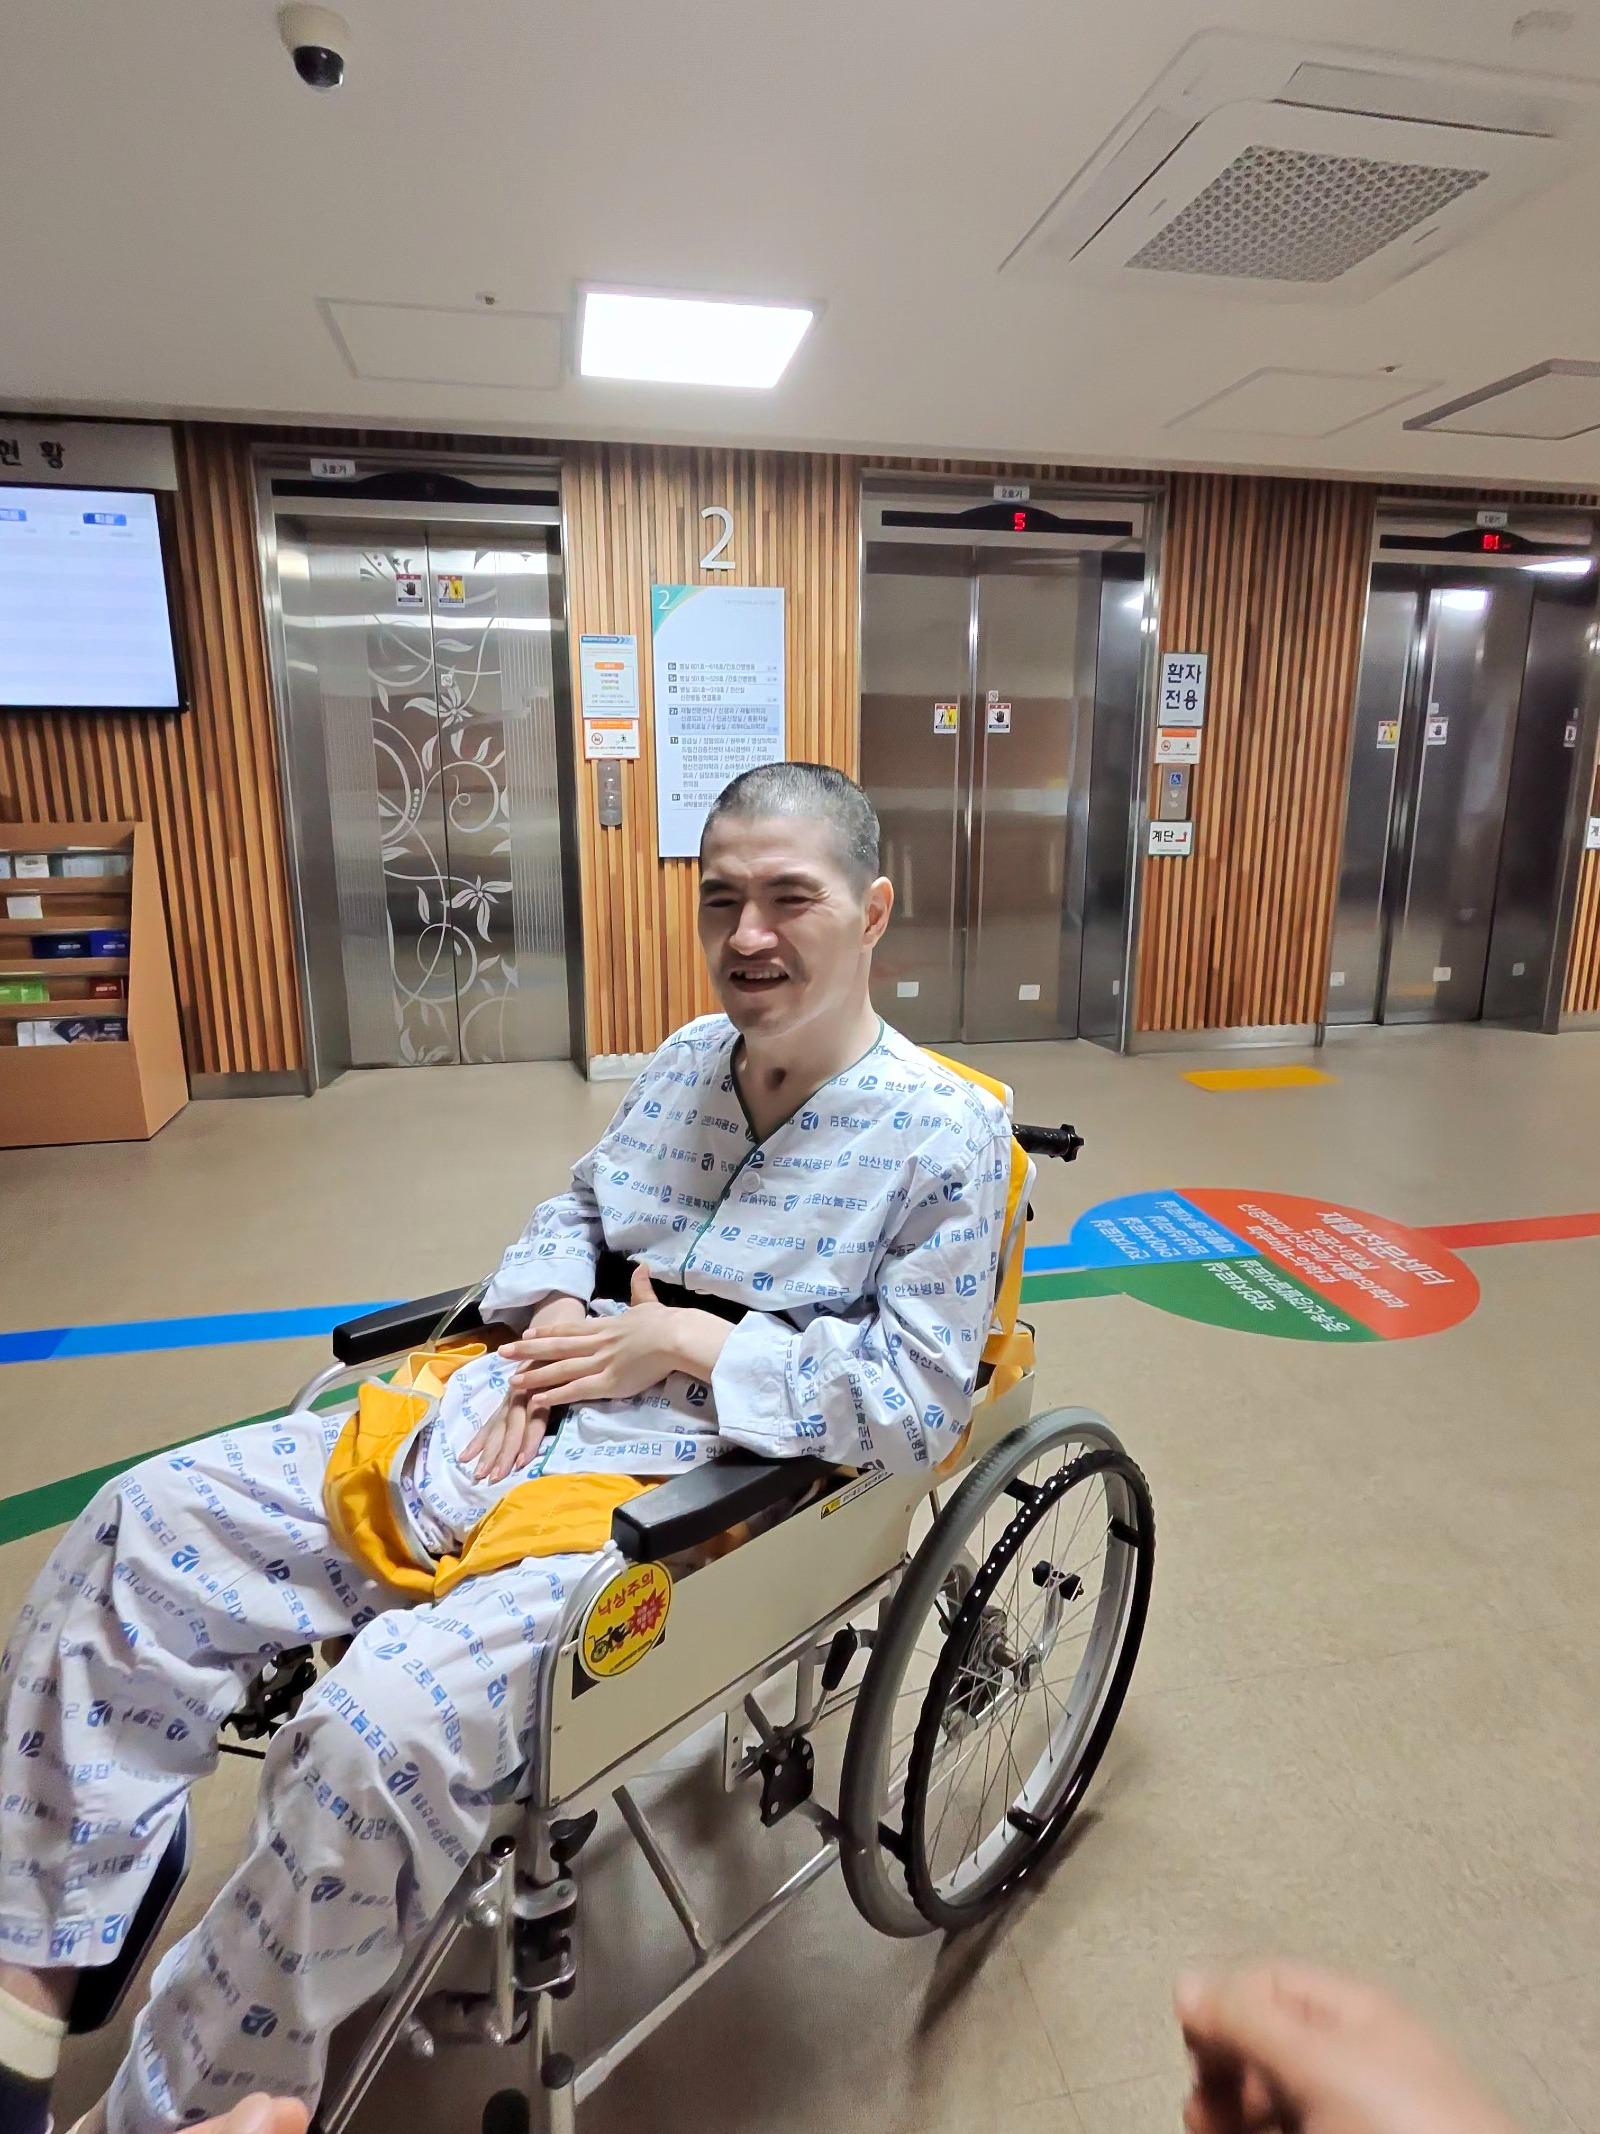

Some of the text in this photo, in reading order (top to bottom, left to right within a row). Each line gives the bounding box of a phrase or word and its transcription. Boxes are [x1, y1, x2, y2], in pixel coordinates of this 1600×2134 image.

[1014, 512, 1026, 531] 5
[701, 506, 736, 568] 2
[657, 589, 672, 610] 2
[1167, 663, 1202, 684] 환자
[1165, 689, 1198, 711] 전용
[1152, 830, 1174, 843] 계단
[773, 1157, 832, 1170] 근로복지공단
[746, 1234, 806, 1250] 근로복지공단
[1089, 1219, 1151, 1260] 전기치료실
[1118, 1216, 1181, 1257] 언어치료실
[1304, 1228, 1380, 1271] 인공신장실
[1316, 1211, 1455, 1286] 재활전문센터
[701, 1260, 744, 1282] 안산병원
[894, 1282, 946, 1298] 안산병원
[1201, 1262, 1277, 1311] 작업치료실
[591, 1442, 662, 1457] 근로복지공단
